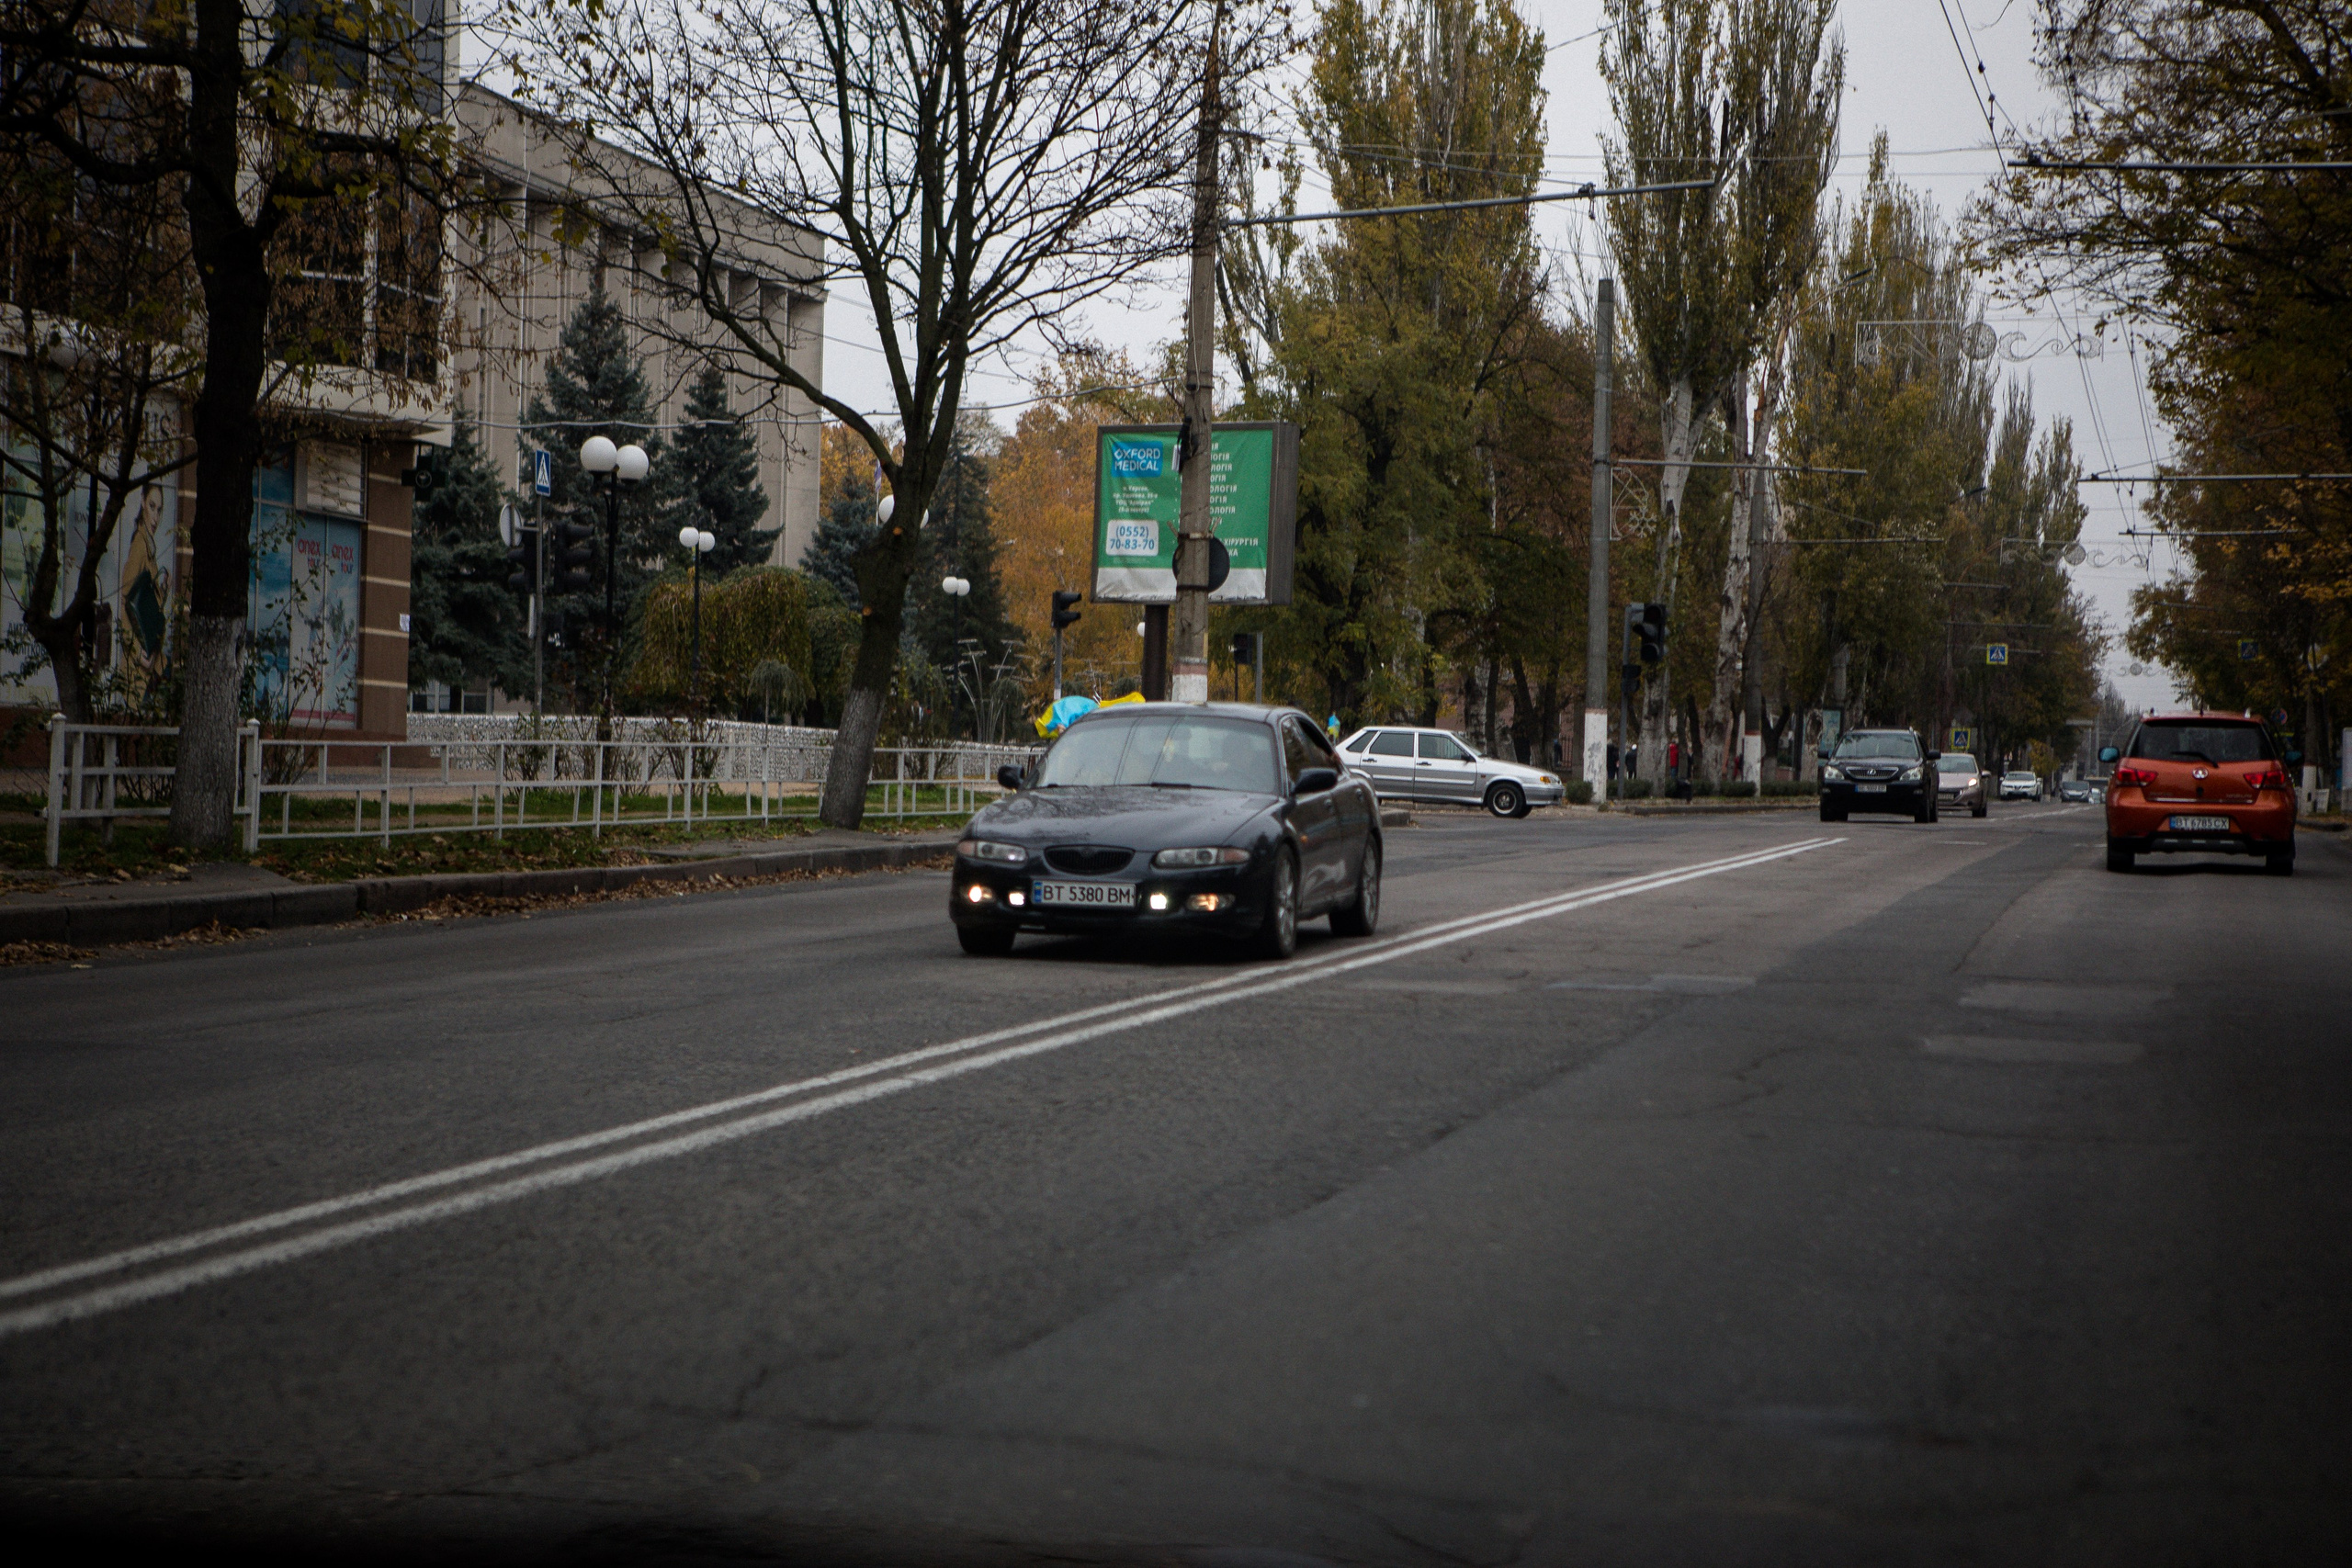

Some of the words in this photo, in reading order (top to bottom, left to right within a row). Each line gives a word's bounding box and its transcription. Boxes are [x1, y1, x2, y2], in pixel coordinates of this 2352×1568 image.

[1114, 447, 1160, 460] OXFORD
[1114, 459, 1159, 471] MEDICAL
[1115, 525, 1149, 538] (0552)
[1110, 538, 1155, 550] 70-83-70
[1043, 886, 1065, 901] BT
[1069, 886, 1102, 902] 5380
[1107, 887, 1132, 903] BM
